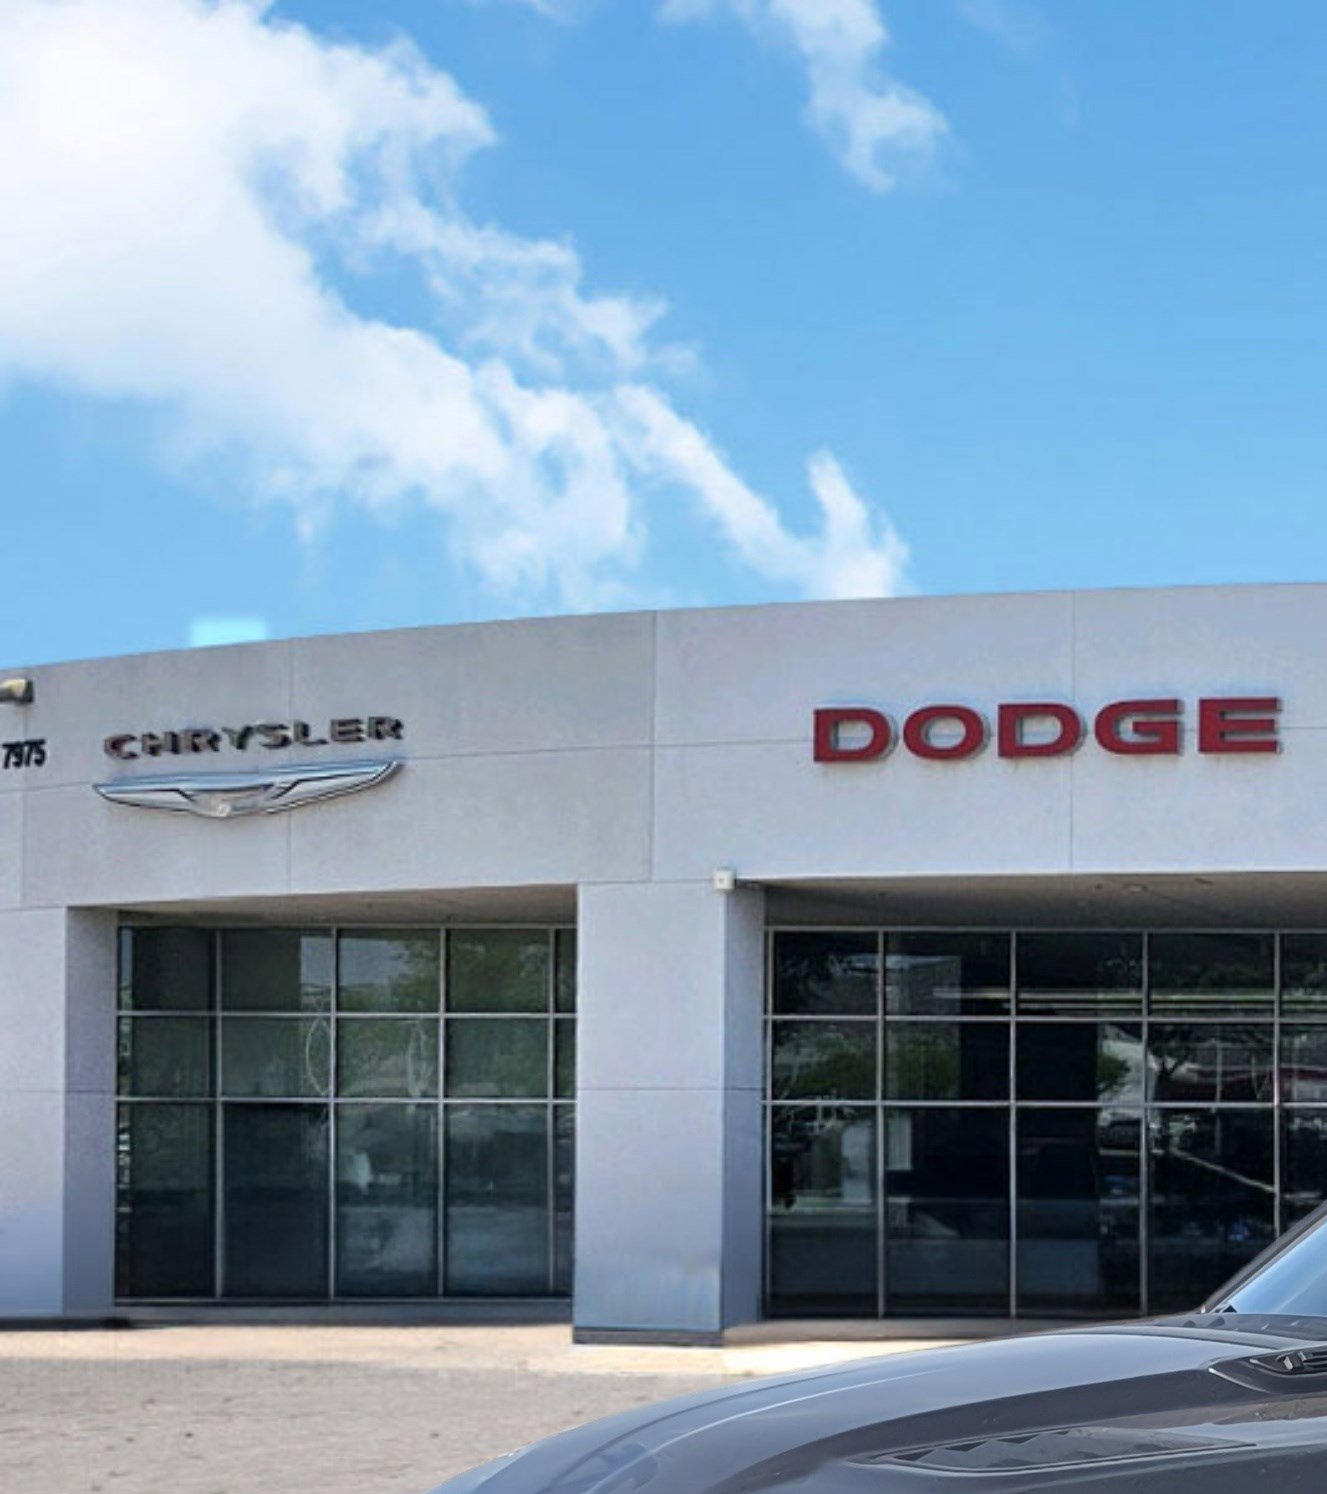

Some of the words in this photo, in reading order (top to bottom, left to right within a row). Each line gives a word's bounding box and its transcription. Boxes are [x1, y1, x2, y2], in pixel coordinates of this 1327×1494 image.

[104, 716, 404, 760] CHRYSLER
[813, 696, 1282, 763] DODGE
[2, 739, 46, 769] 7975
